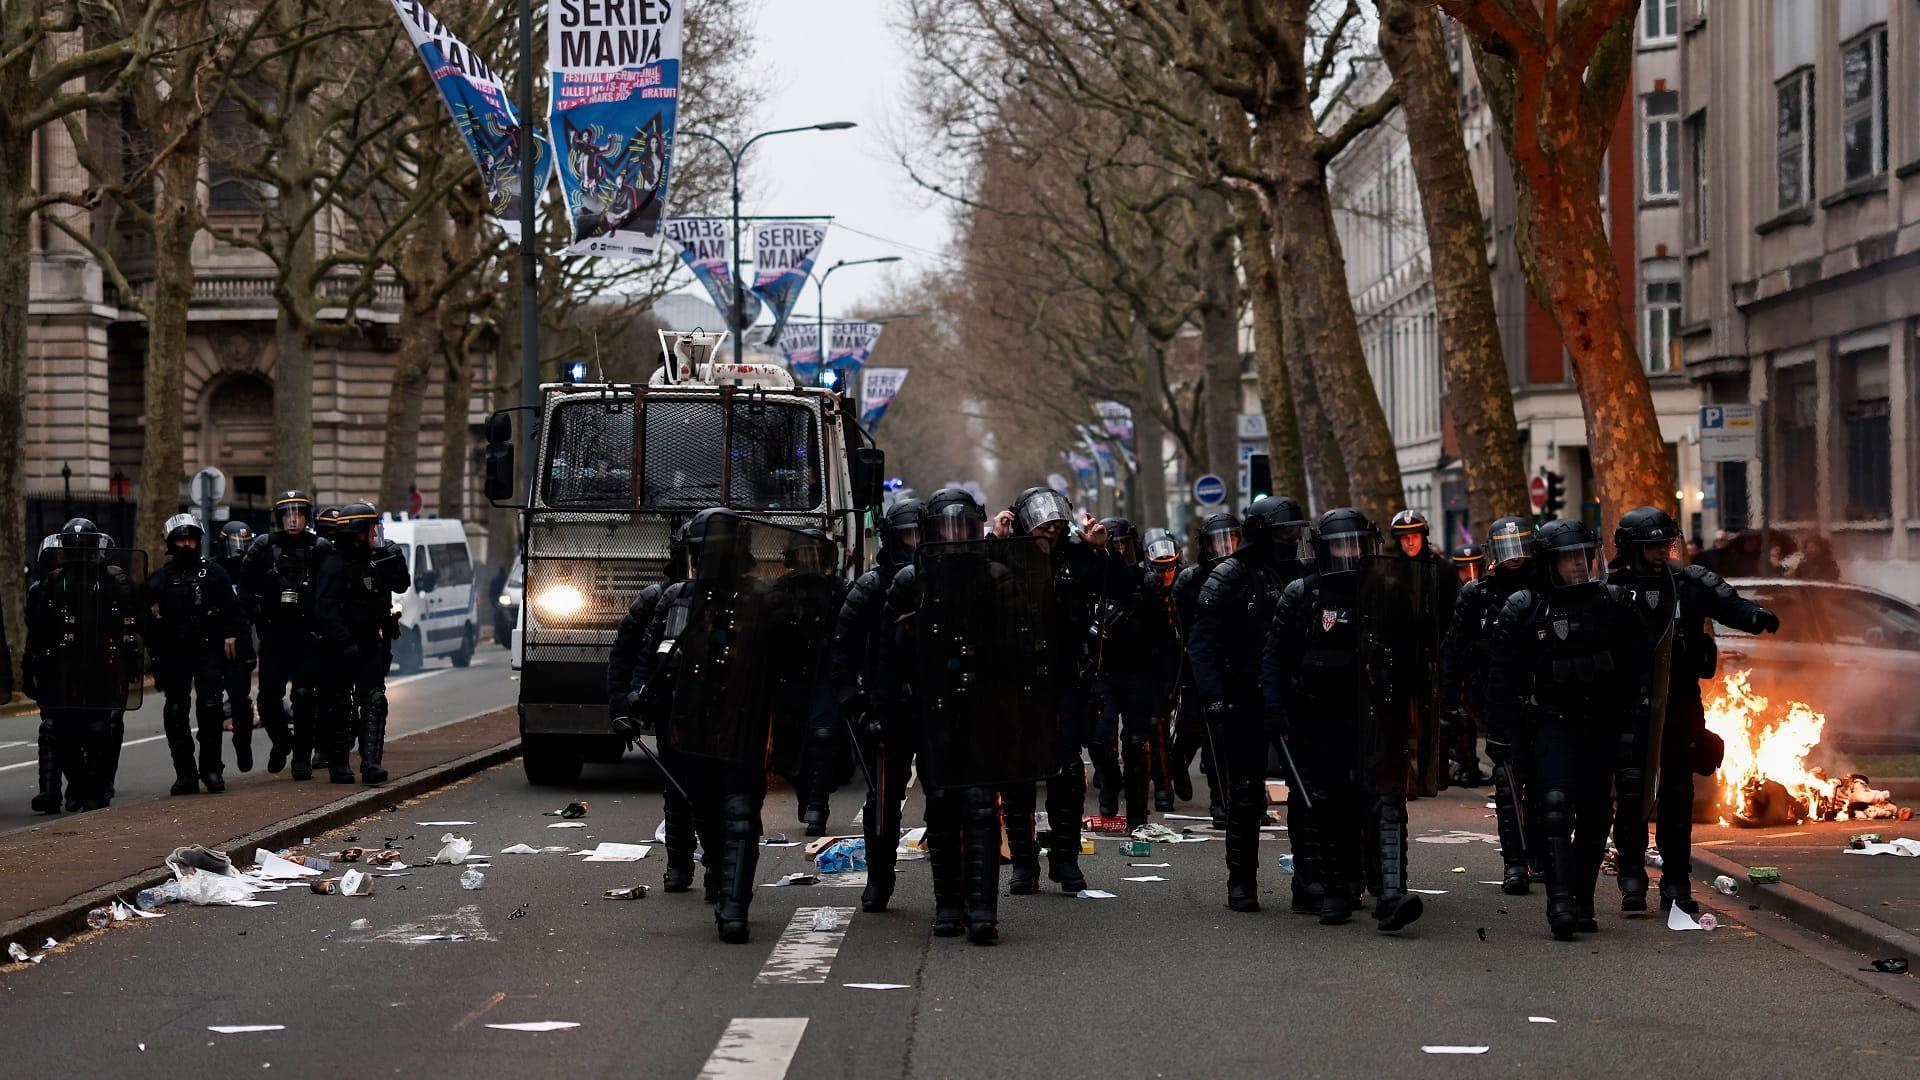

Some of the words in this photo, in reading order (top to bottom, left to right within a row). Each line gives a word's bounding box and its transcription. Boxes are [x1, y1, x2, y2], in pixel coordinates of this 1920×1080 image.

[560, 0, 671, 27] SERIES
[560, 28, 661, 67] MANIA
[563, 73, 604, 83] FESTIVAL
[561, 87, 585, 97] LILLE
[641, 87, 678, 98] GRATUIT
[759, 227, 824, 248] SERIES
[759, 248, 815, 269] MAN
